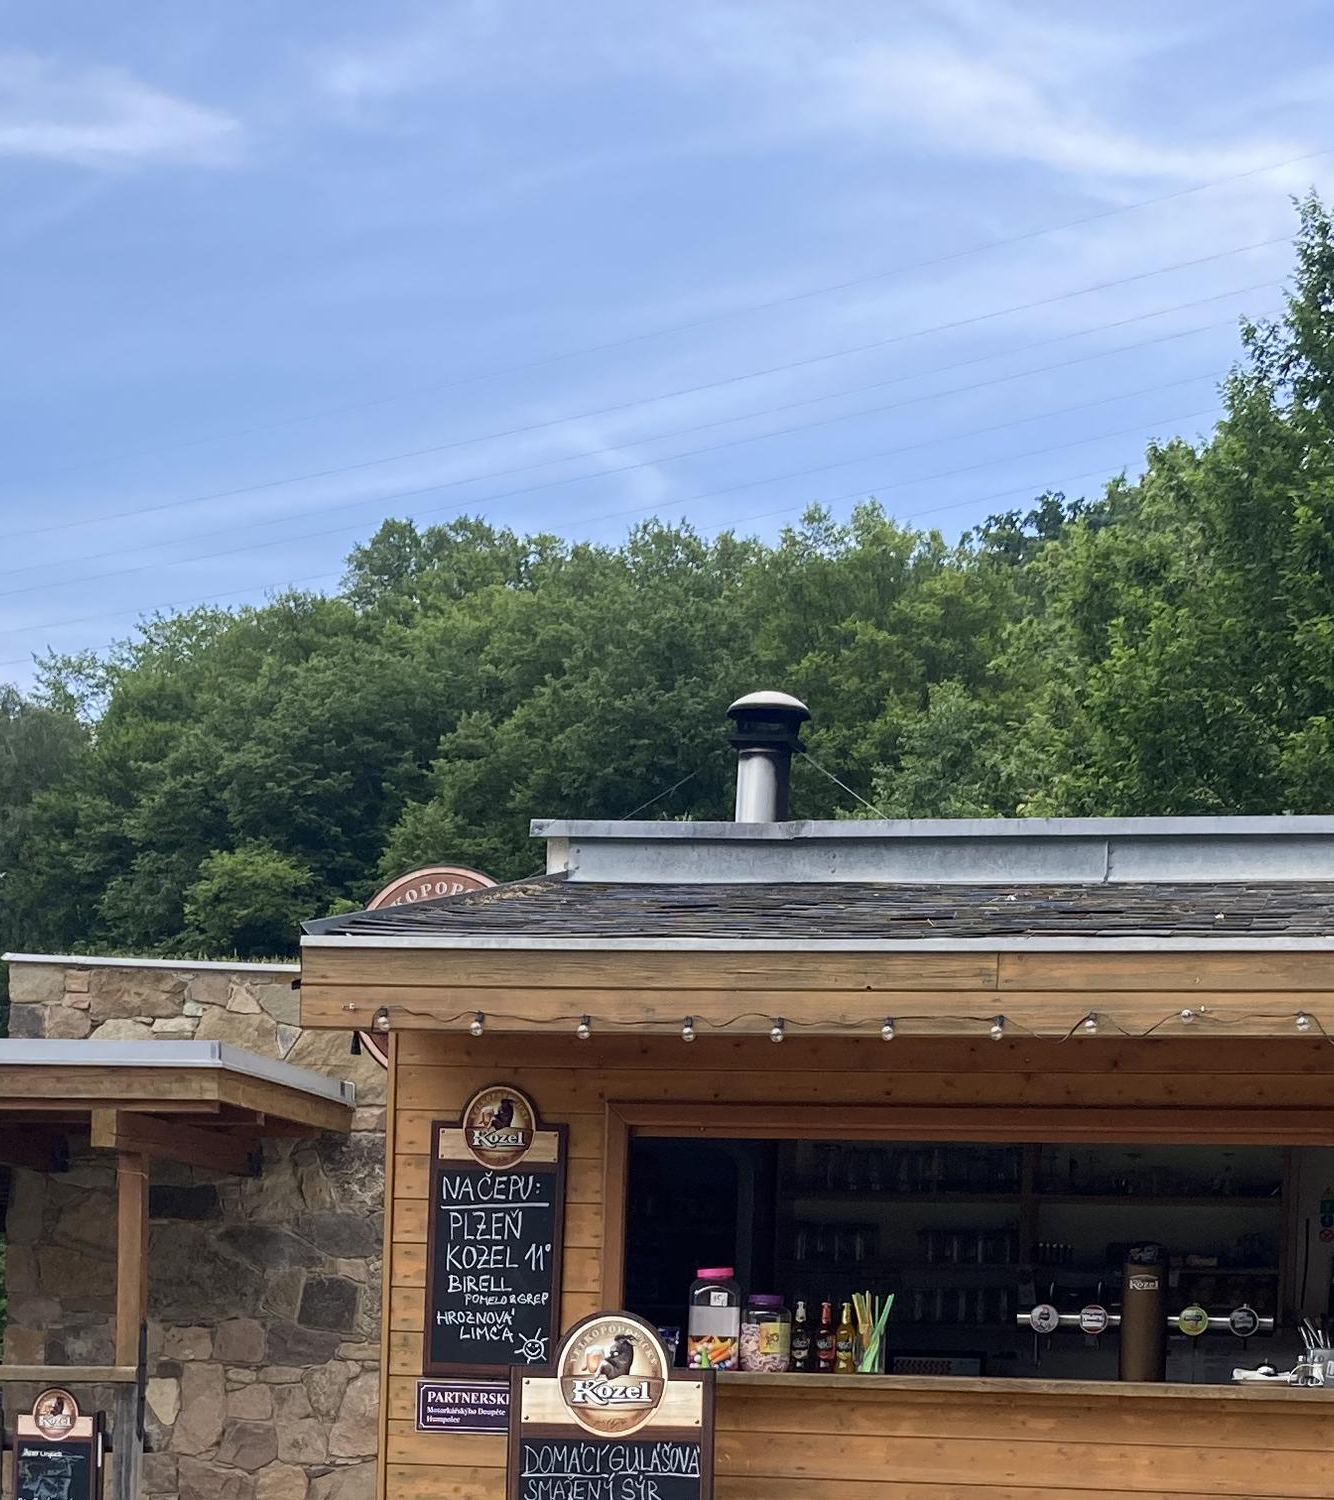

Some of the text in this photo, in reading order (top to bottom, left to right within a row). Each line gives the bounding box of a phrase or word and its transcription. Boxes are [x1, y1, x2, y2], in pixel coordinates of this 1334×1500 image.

[472, 1130, 525, 1148] Kozel
[449, 1209, 522, 1240] PLZEŇ
[446, 1243, 519, 1271] KOZEL
[447, 1274, 512, 1293] BIRELL
[436, 1308, 515, 1325] HROZNOVÁ
[572, 1380, 652, 1405] Kozel
[524, 1442, 610, 1473] DOMÁCÍ
